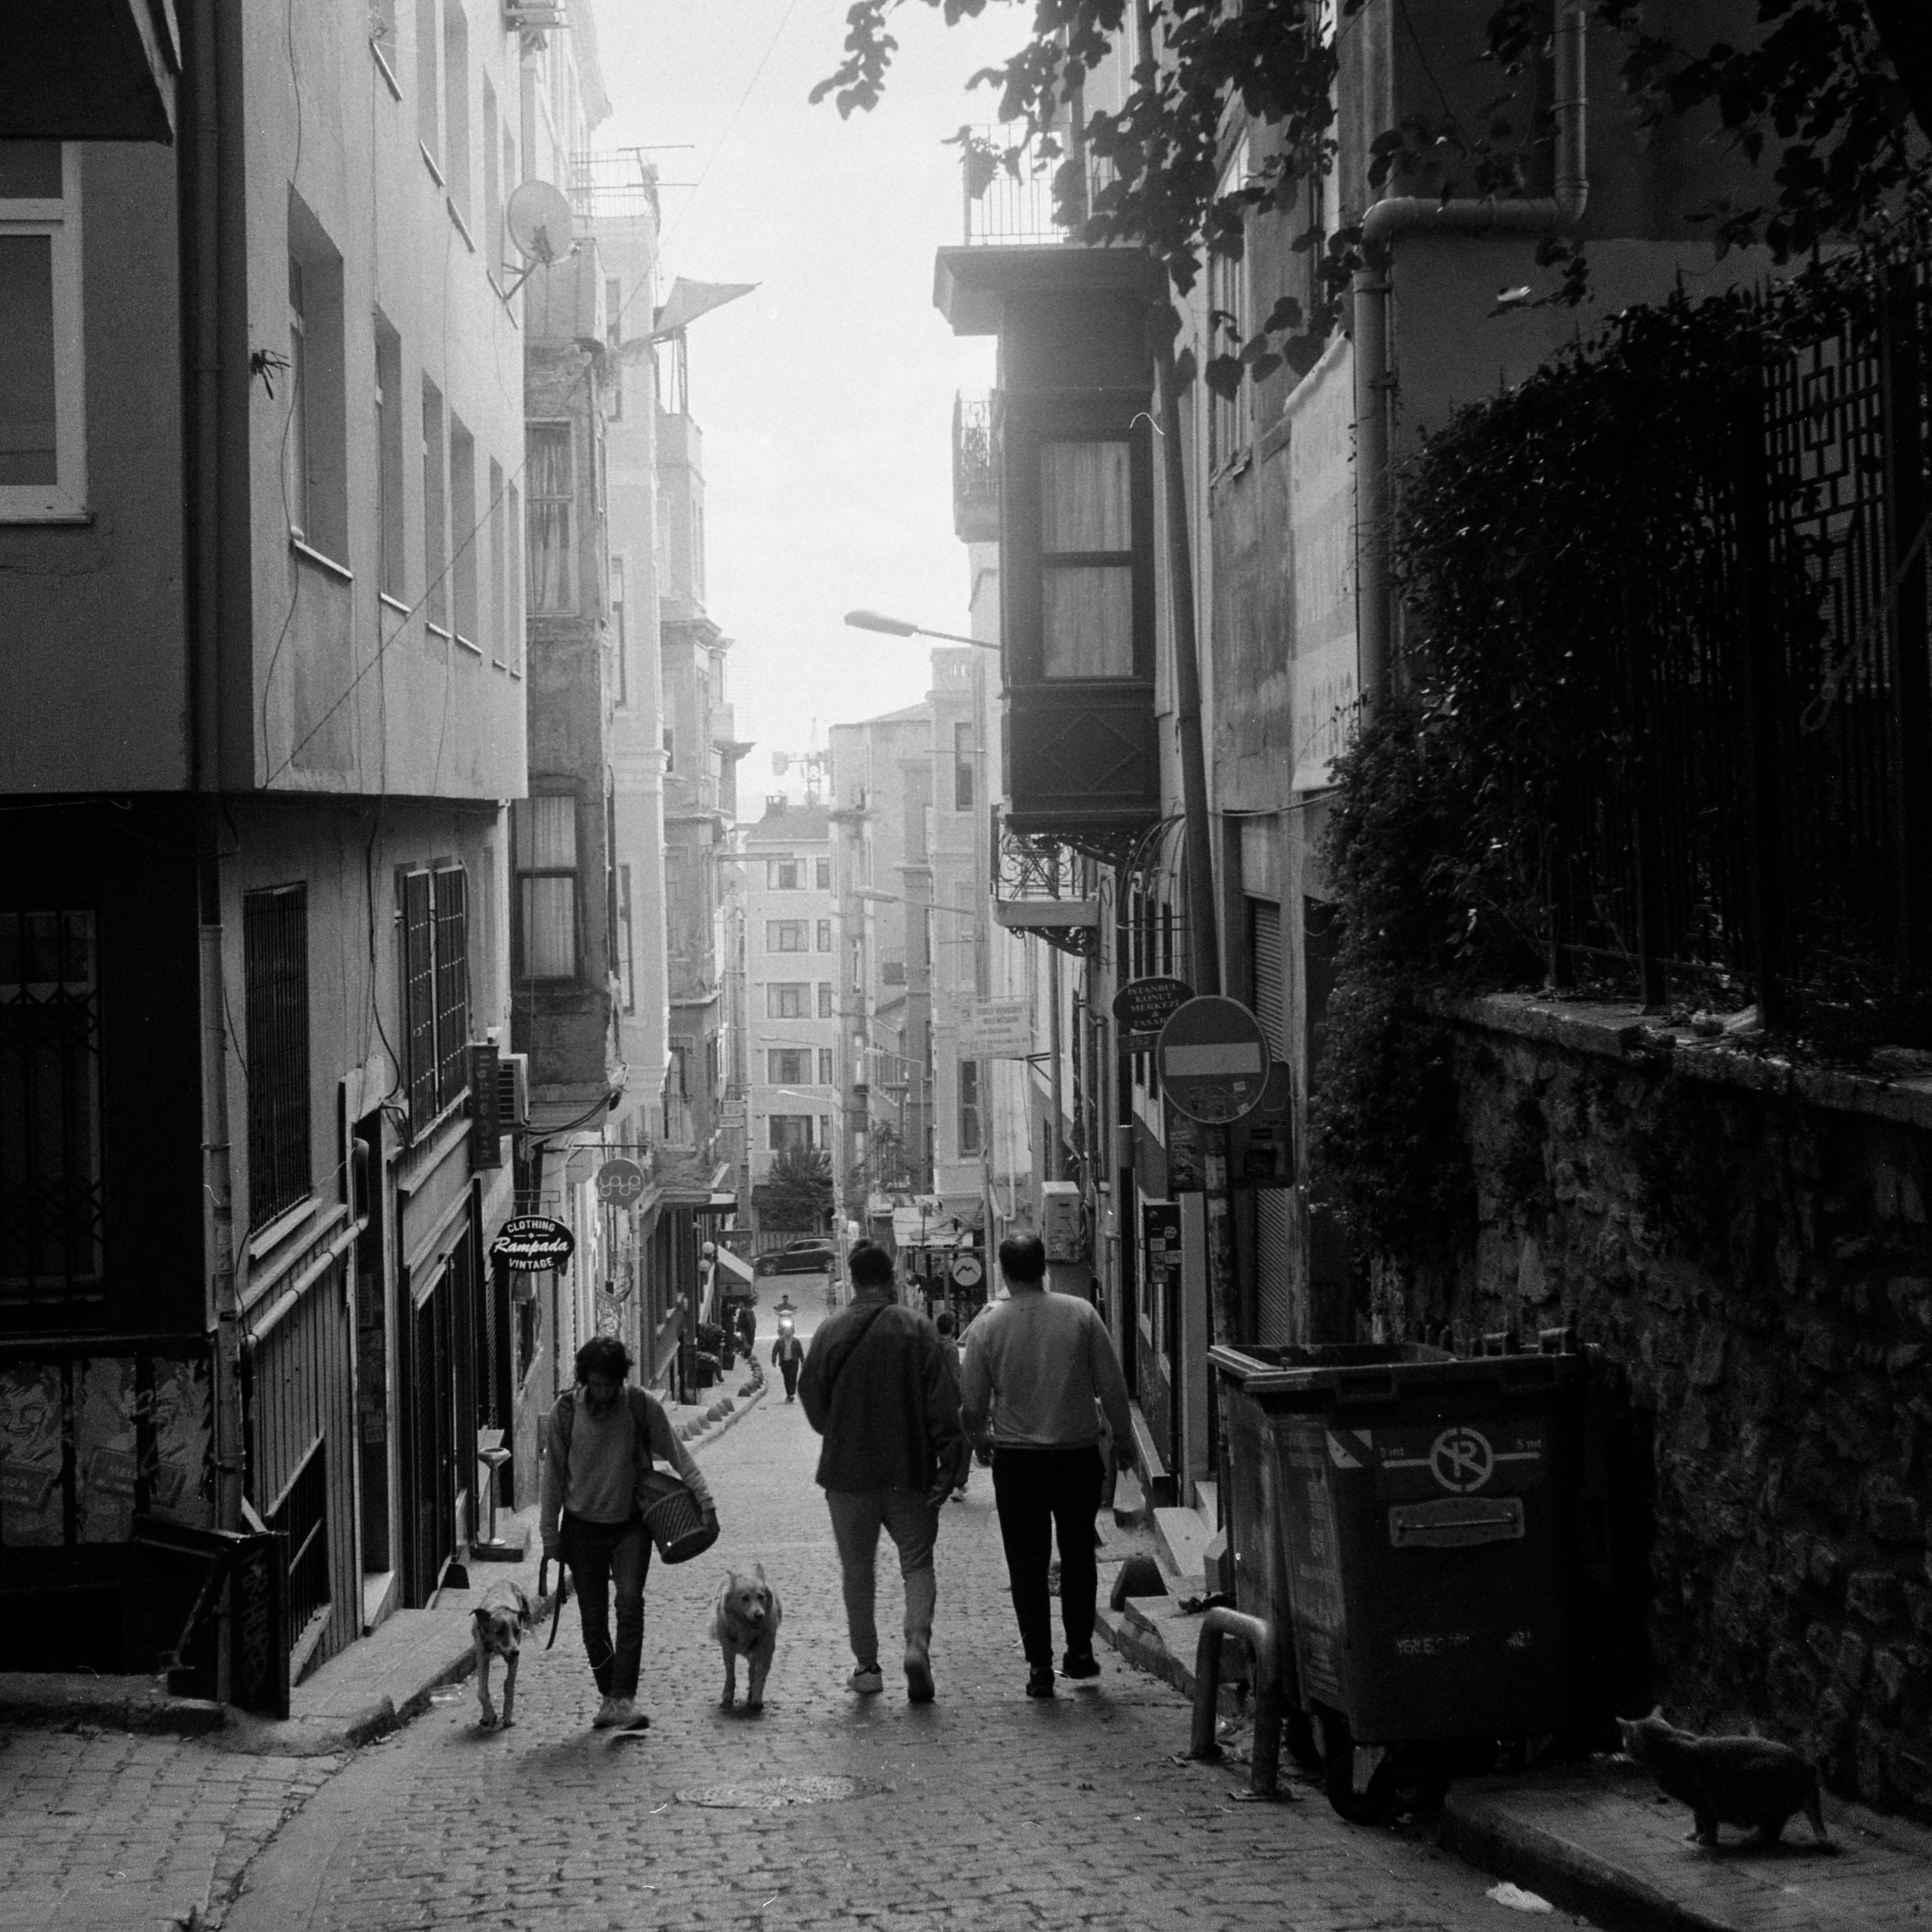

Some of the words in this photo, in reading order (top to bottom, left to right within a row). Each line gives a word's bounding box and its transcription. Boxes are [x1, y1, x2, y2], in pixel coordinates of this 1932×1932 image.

[1136, 992, 1171, 1003] KONUT
[1131, 998, 1179, 1012] MERKEZİ
[1134, 1017, 1168, 1027] TASAR
[507, 1220, 555, 1234] CLOTHING
[494, 1236, 569, 1257] Rampada
[509, 1257, 555, 1270] VINTAGE
[1527, 1438, 1543, 1449] mt
[1389, 1447, 1404, 1457] mt
